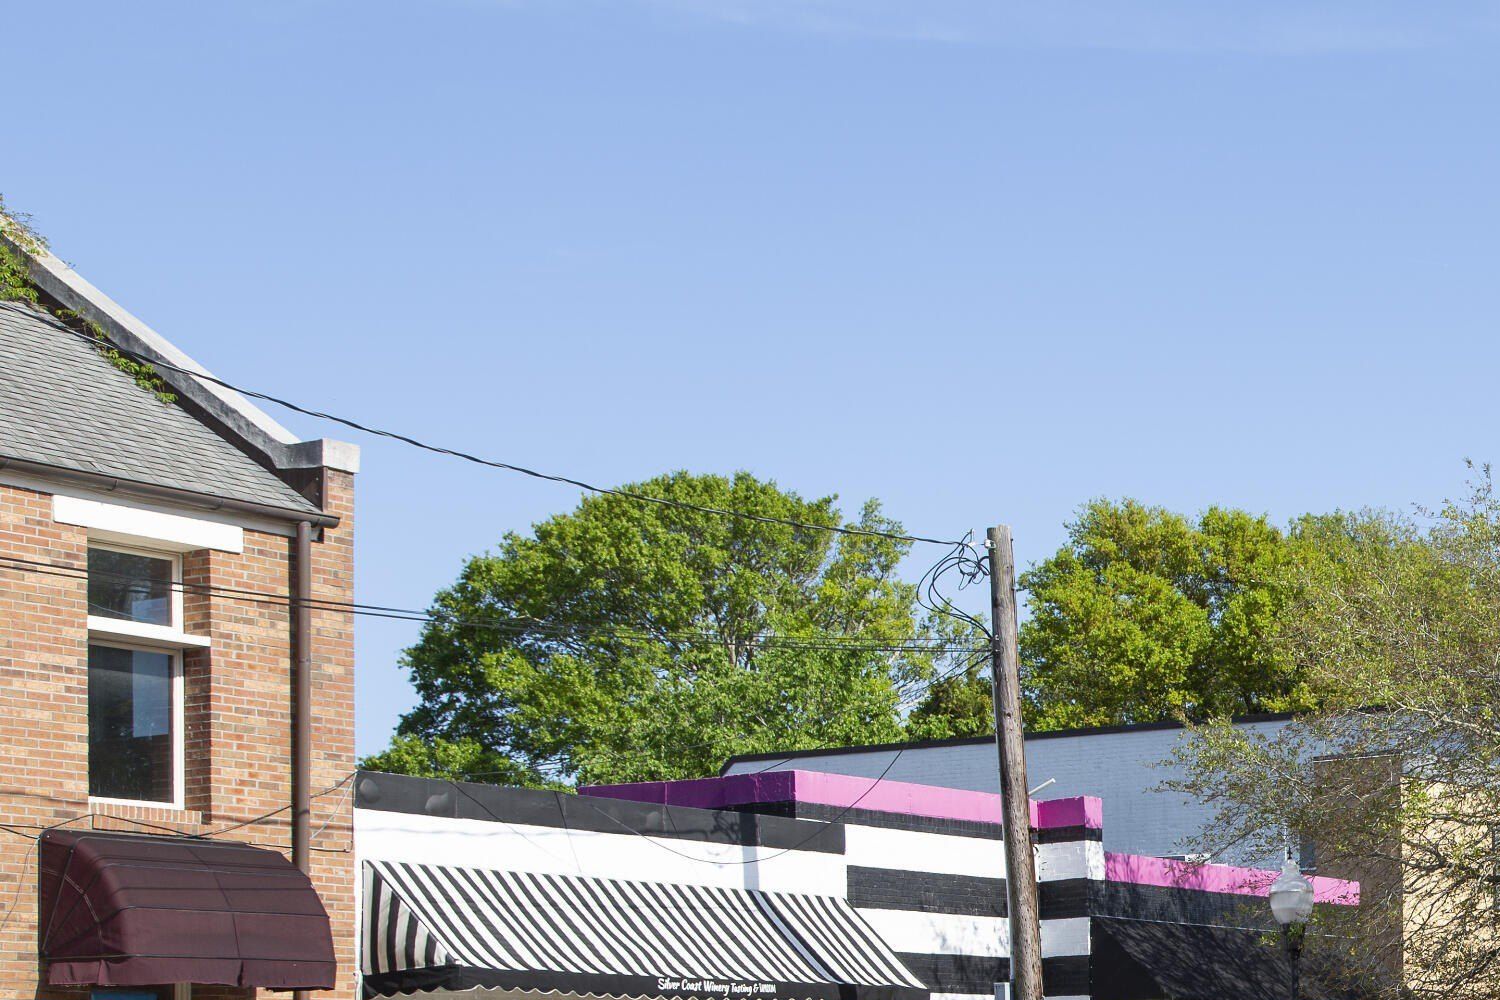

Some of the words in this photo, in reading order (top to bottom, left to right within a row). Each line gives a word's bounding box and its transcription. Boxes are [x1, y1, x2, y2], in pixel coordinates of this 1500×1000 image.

[658, 977, 680, 991] Silver
[681, 978, 702, 992] Coast
[703, 980, 730, 996] Winery
[730, 983, 752, 996] Tasting
[753, 984, 759, 993] &
